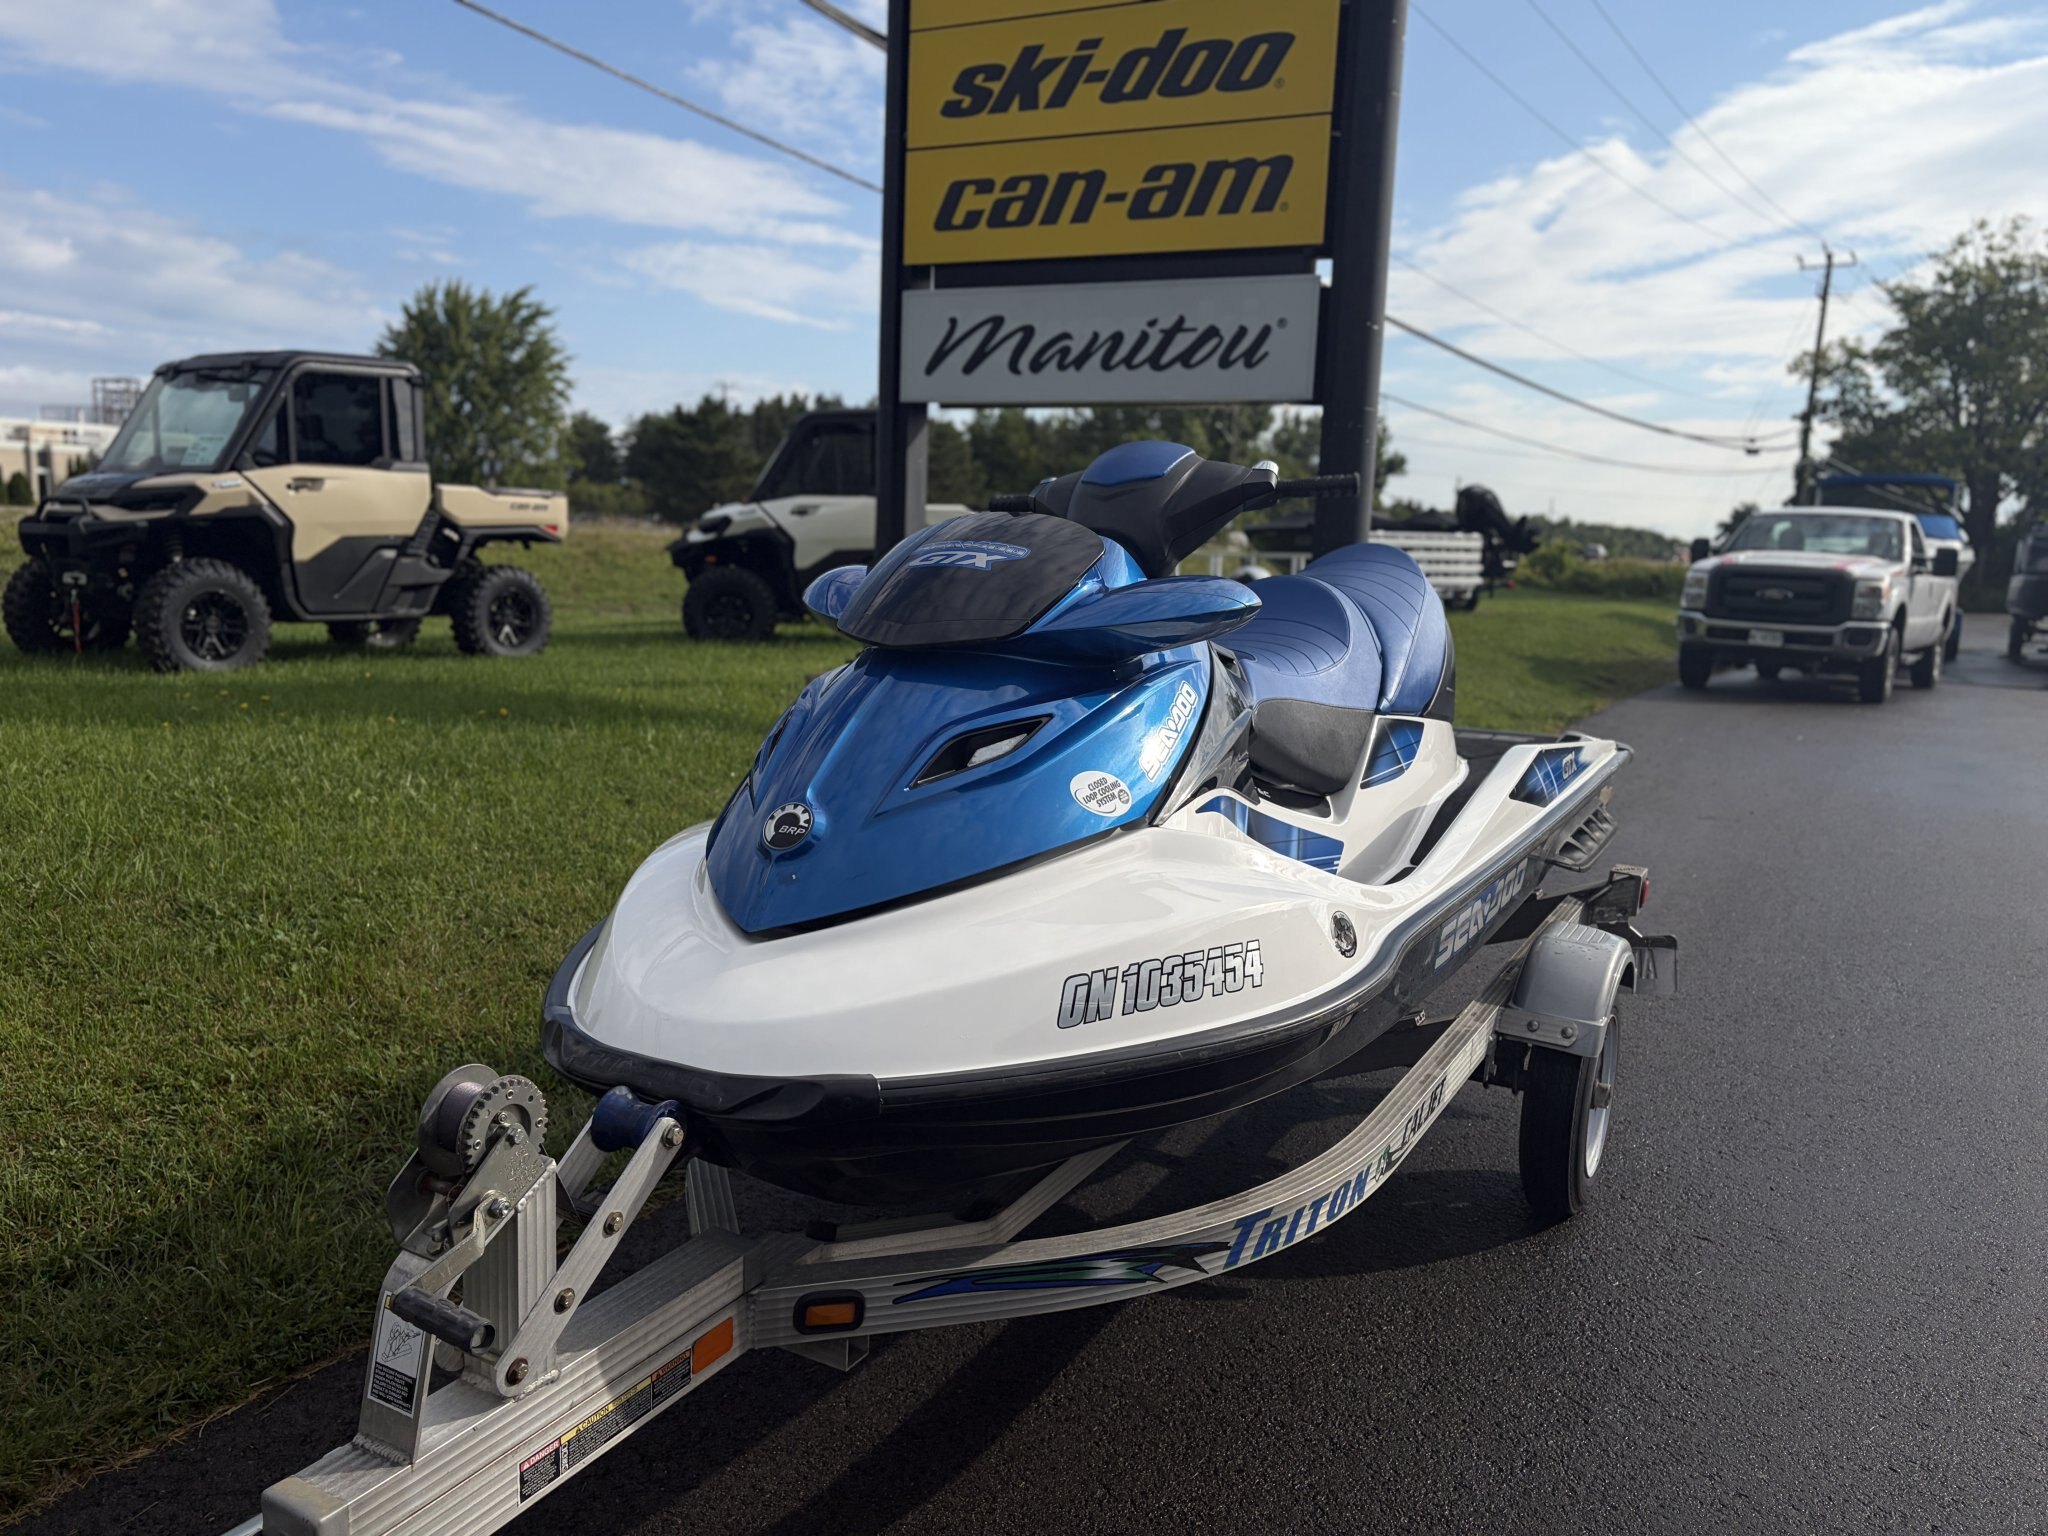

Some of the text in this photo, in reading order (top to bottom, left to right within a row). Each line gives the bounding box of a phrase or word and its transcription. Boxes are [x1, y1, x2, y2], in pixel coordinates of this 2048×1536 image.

[940, 27, 1296, 118] ski-doo
[933, 155, 1294, 232] can-am
[925, 314, 1272, 377] Manitou
[909, 551, 1007, 568] GTX
[1082, 780, 1121, 804] LOOP COOLING
[1087, 777, 1107, 791] CLOSED
[1096, 792, 1117, 807] SYSTEM
[778, 825, 805, 836] BRP
[1057, 939, 1264, 1029] ON 1035454
[581, 1407, 610, 1429] CAUTION
[531, 1442, 560, 1466] DANGER
